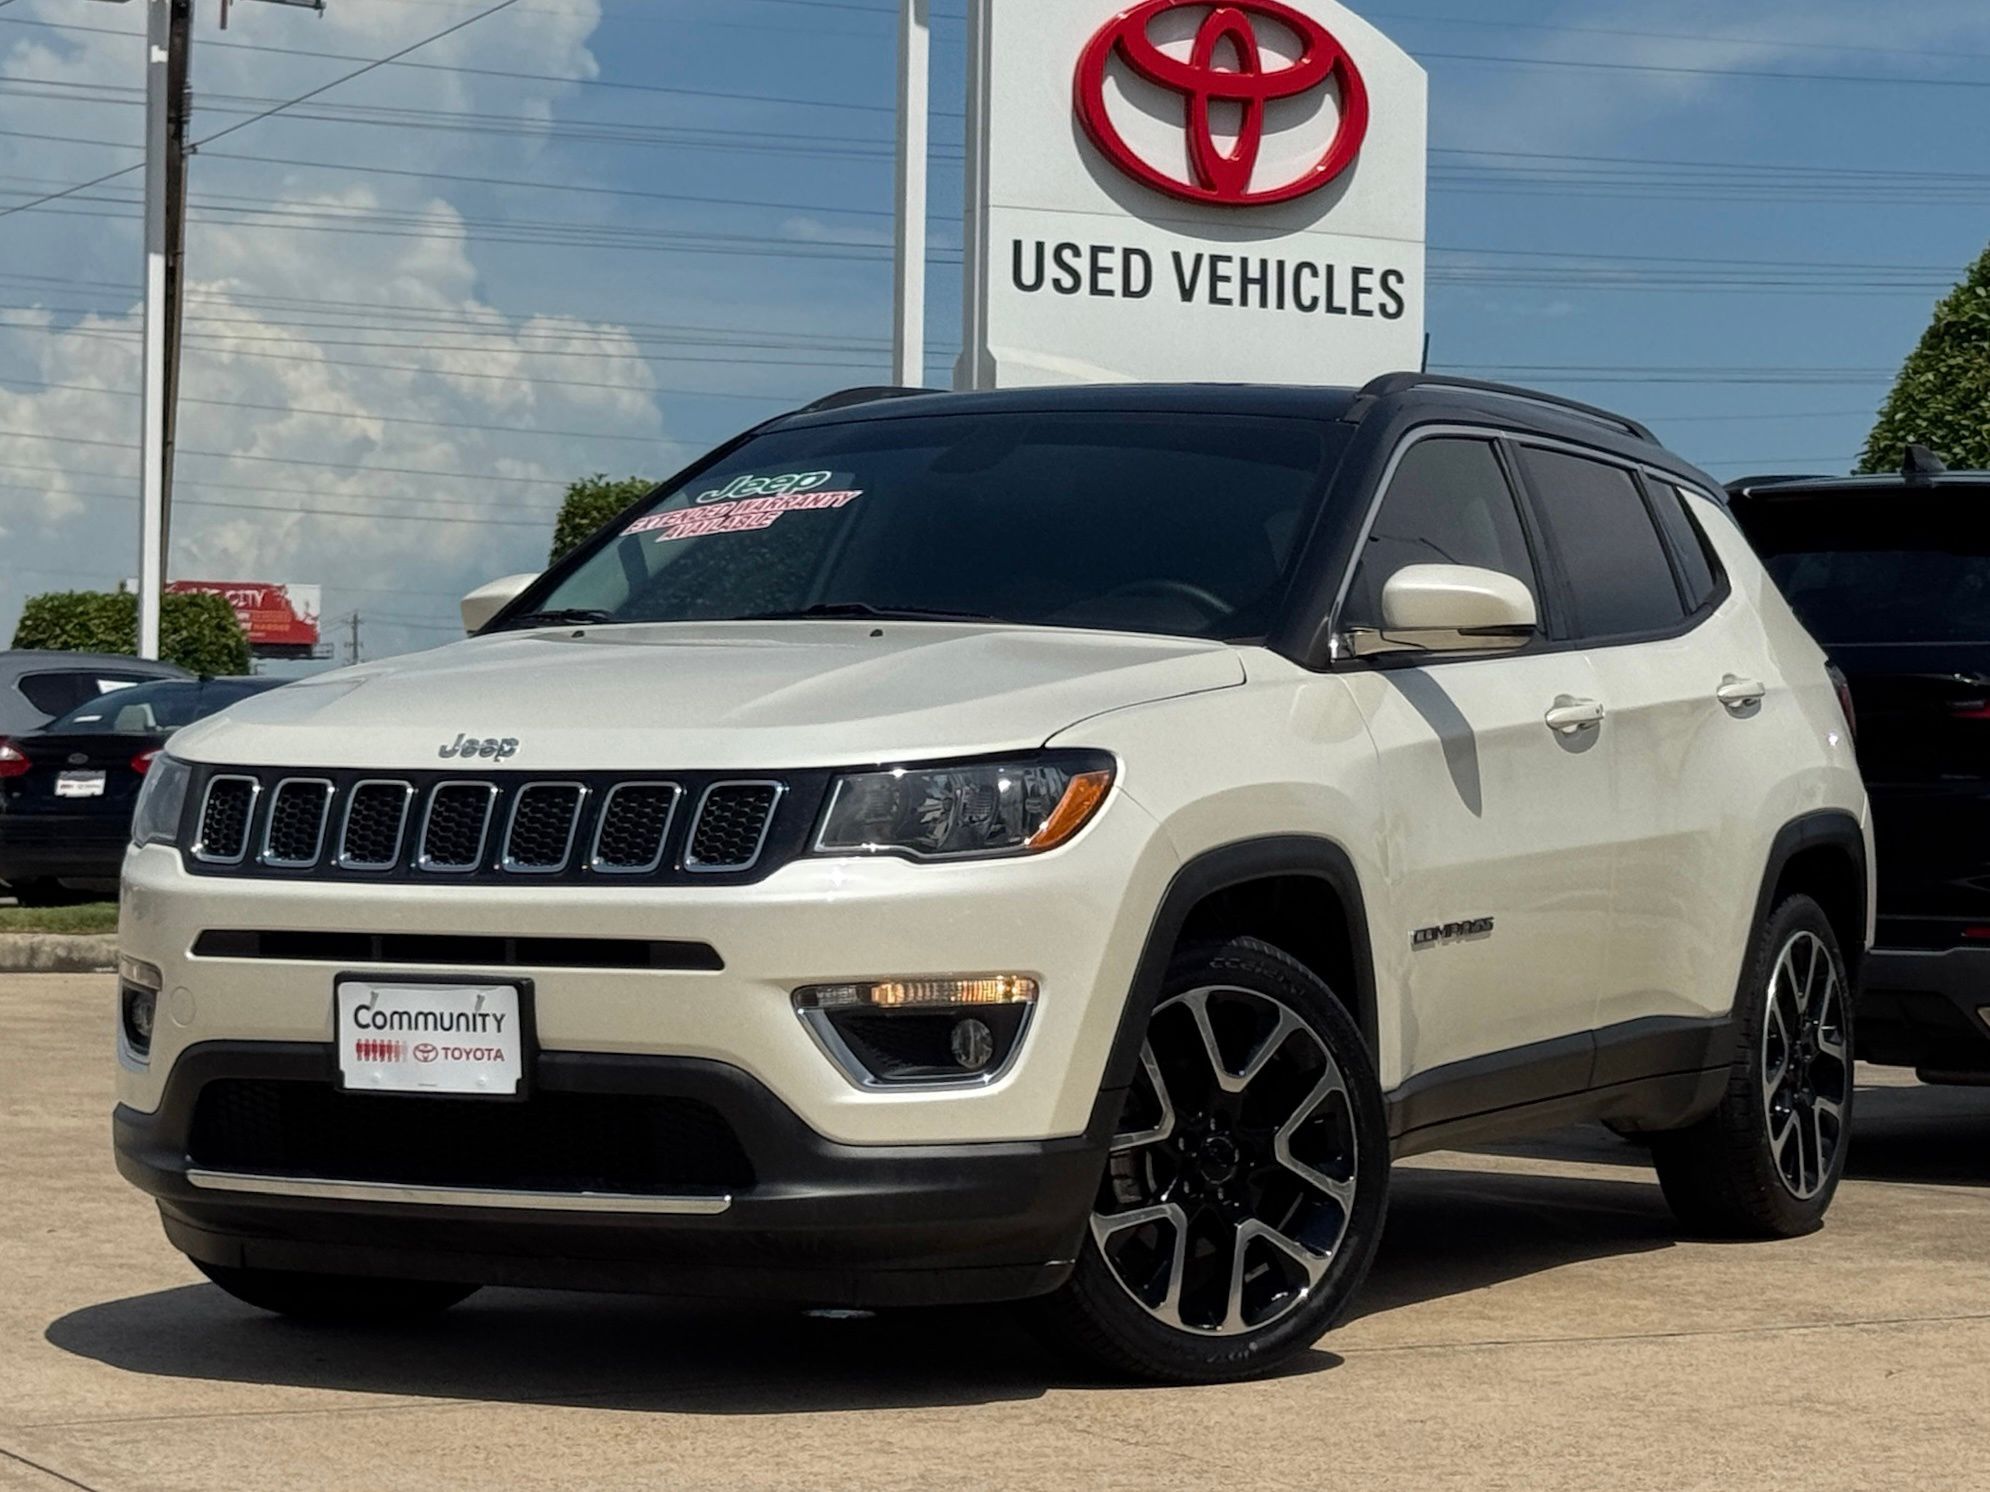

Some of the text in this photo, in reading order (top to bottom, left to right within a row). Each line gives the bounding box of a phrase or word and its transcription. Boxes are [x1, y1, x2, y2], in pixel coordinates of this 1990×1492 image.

[1012, 239, 1406, 320] USED VEHICLES
[696, 471, 832, 503] Jeep
[626, 491, 860, 534] EXTENDED WARRANTY
[660, 511, 782, 541] AVAILABLE
[438, 733, 519, 762] Jeep
[441, 1046, 505, 1062] TOYOTA
